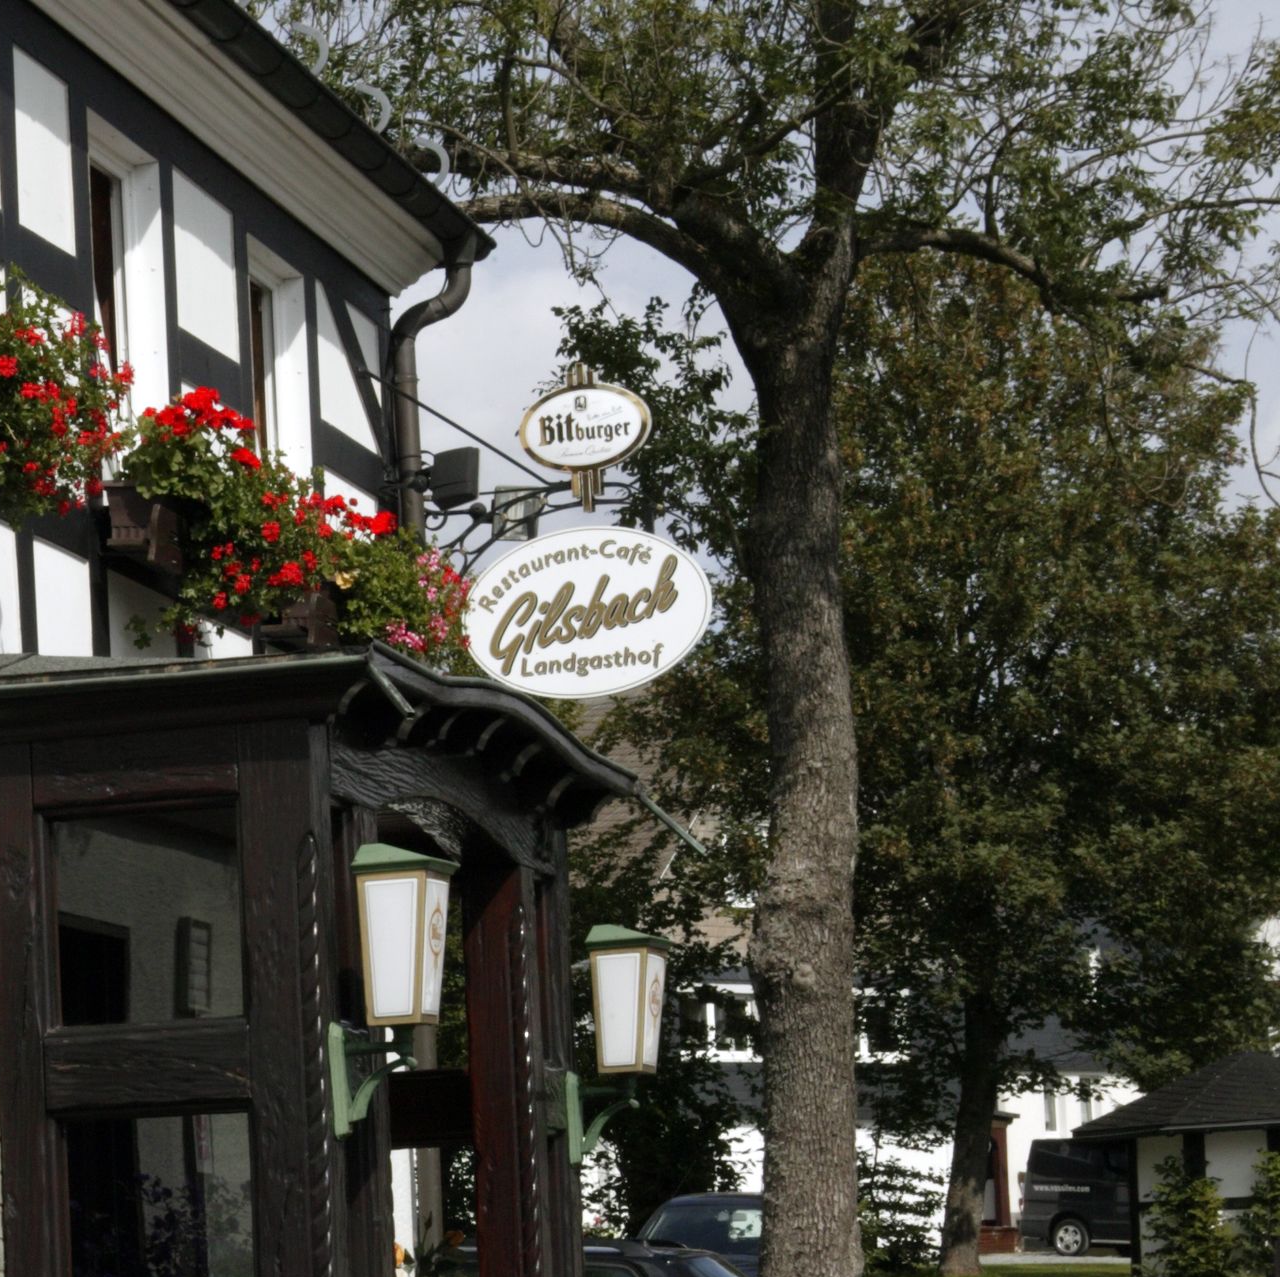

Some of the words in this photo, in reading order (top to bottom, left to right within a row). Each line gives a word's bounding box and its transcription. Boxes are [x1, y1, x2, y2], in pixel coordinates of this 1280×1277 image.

[539, 412, 630, 447] Bitburger
[478, 539, 653, 613] Restaurant-Café
[490, 553, 679, 676] Gilsbach
[520, 643, 664, 677] Landgasthof
